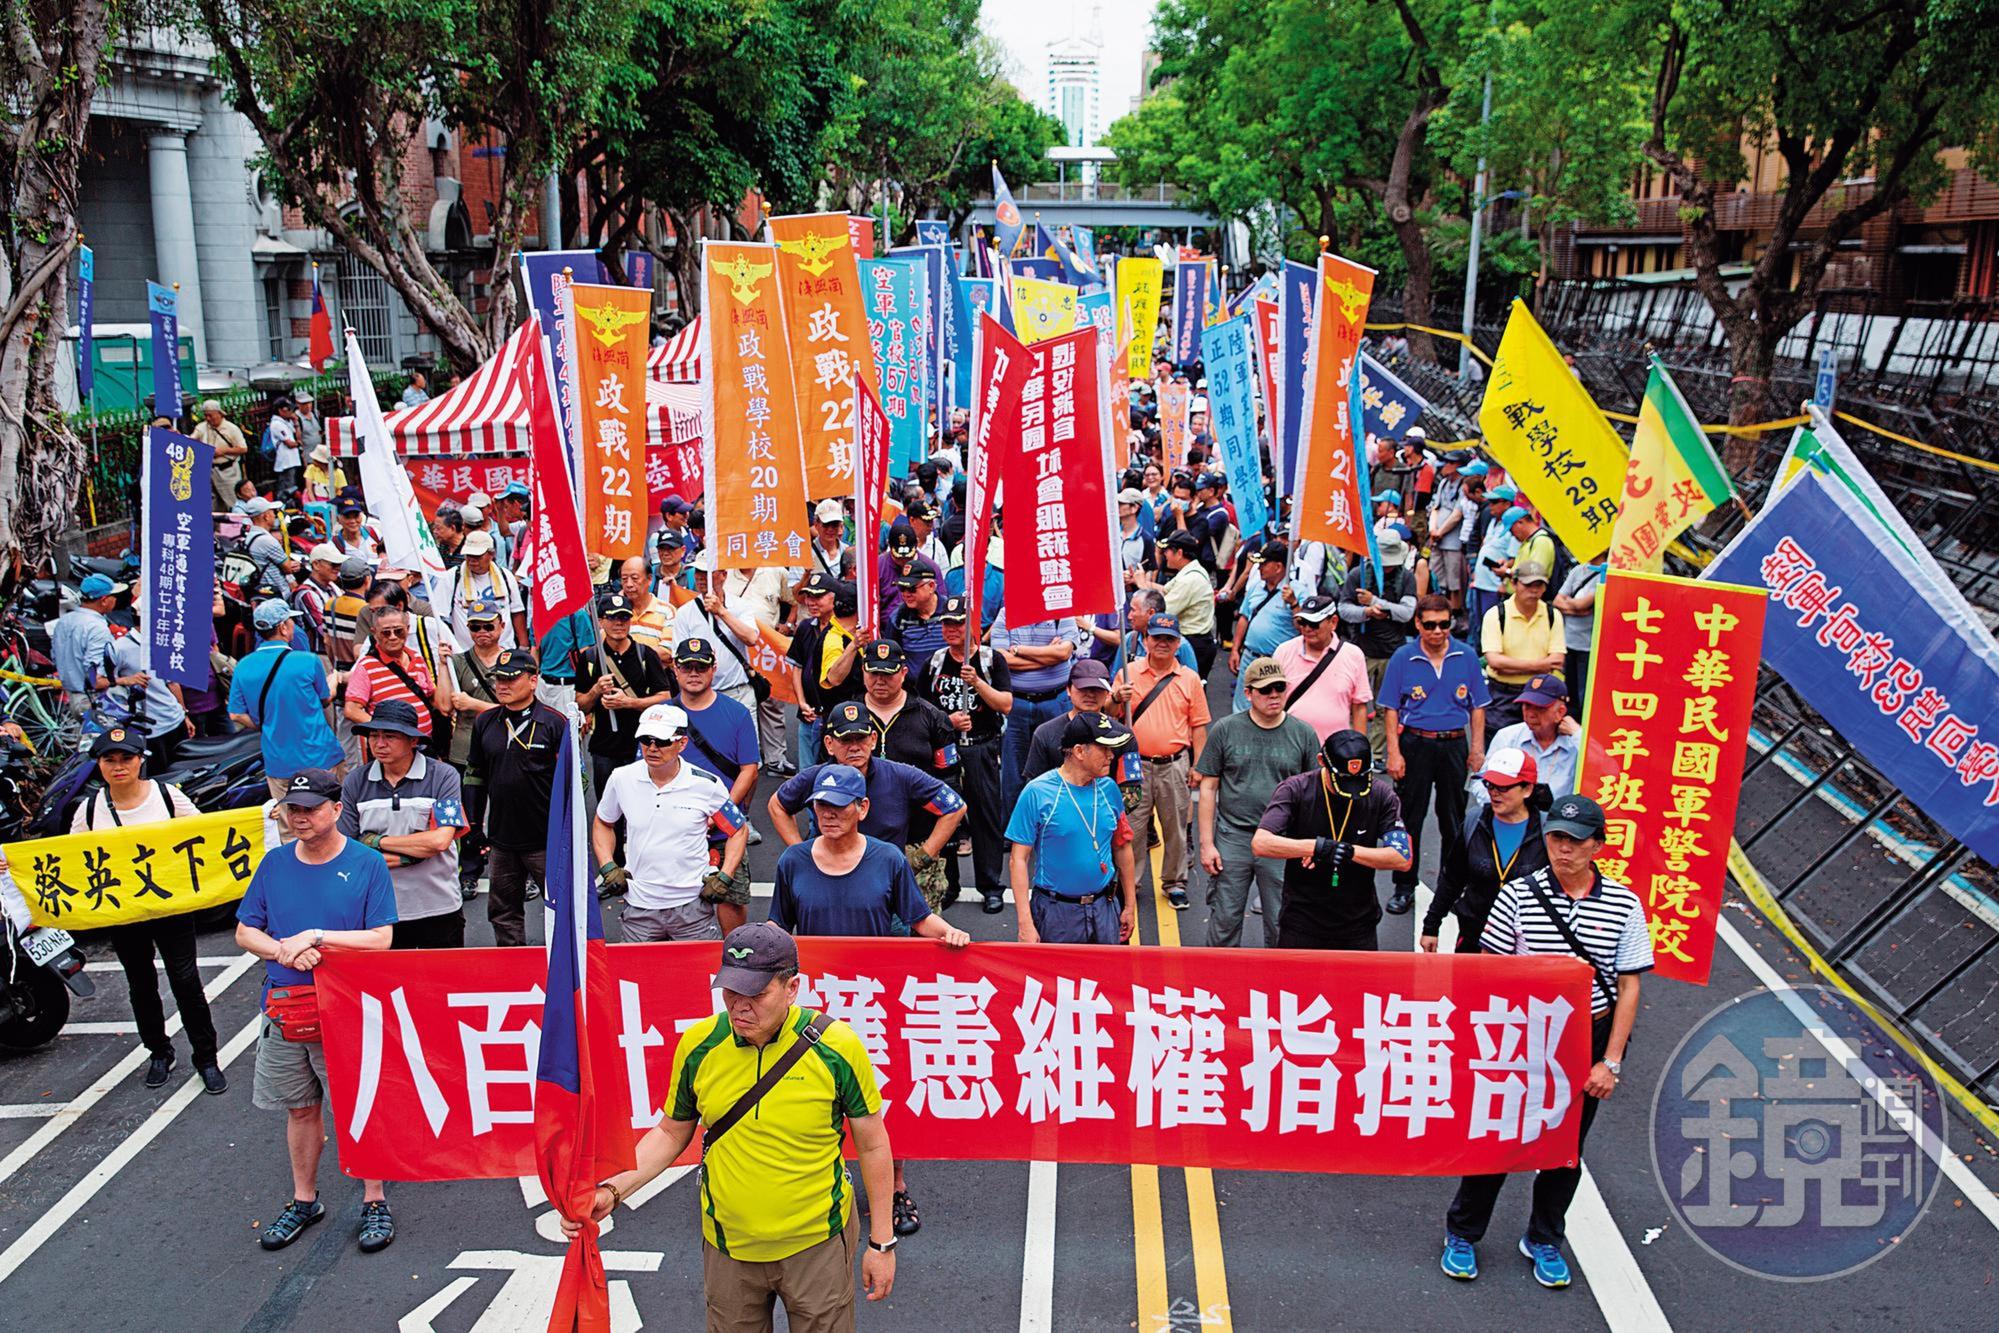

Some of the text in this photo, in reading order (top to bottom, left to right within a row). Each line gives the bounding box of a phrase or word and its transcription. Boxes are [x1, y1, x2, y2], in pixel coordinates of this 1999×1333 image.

[872, 266, 897, 317] 空軍
[738, 328, 778, 524] 政戰學校20期
[886, 318, 908, 419] 官校57期
[1209, 337, 1256, 525] 正52期同學會
[165, 443, 184, 460] 48
[407, 463, 533, 494] 華民國
[594, 373, 633, 545] 政戰22期
[1502, 398, 1619, 535] 戰學校29期
[155, 533, 177, 648] 專科48期七十年班
[168, 512, 194, 673] 空軍通信電子學校
[726, 531, 806, 559] 同學會
[1259, 663, 1282, 676] ARMY
[1594, 596, 1665, 887] 七十四年班同學
[1647, 603, 1740, 964] 中華民國軍警院校
[33, 826, 253, 918] 蔡英文下台
[349, 971, 1575, 1145] 八百護憲維權指揮部
